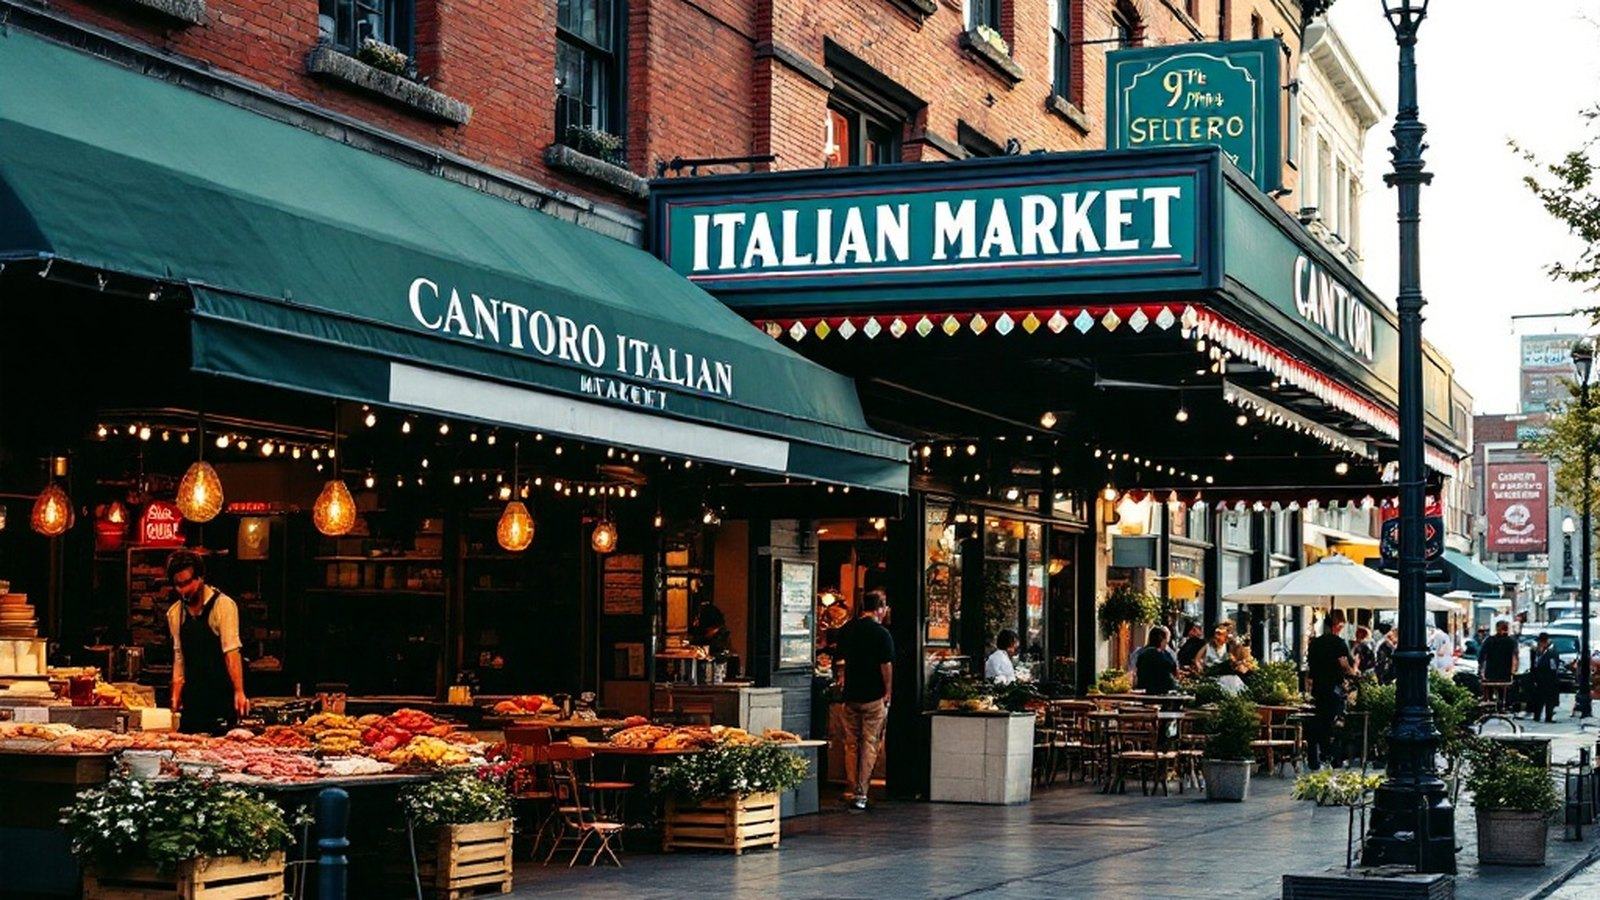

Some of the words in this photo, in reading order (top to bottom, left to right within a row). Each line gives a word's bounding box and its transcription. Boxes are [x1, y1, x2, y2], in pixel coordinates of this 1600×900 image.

[693, 203, 910, 271] ITALIAN
[931, 186, 1181, 260] MARKET
[408, 277, 606, 369] CANTORO
[616, 334, 733, 397] ITALIAN
